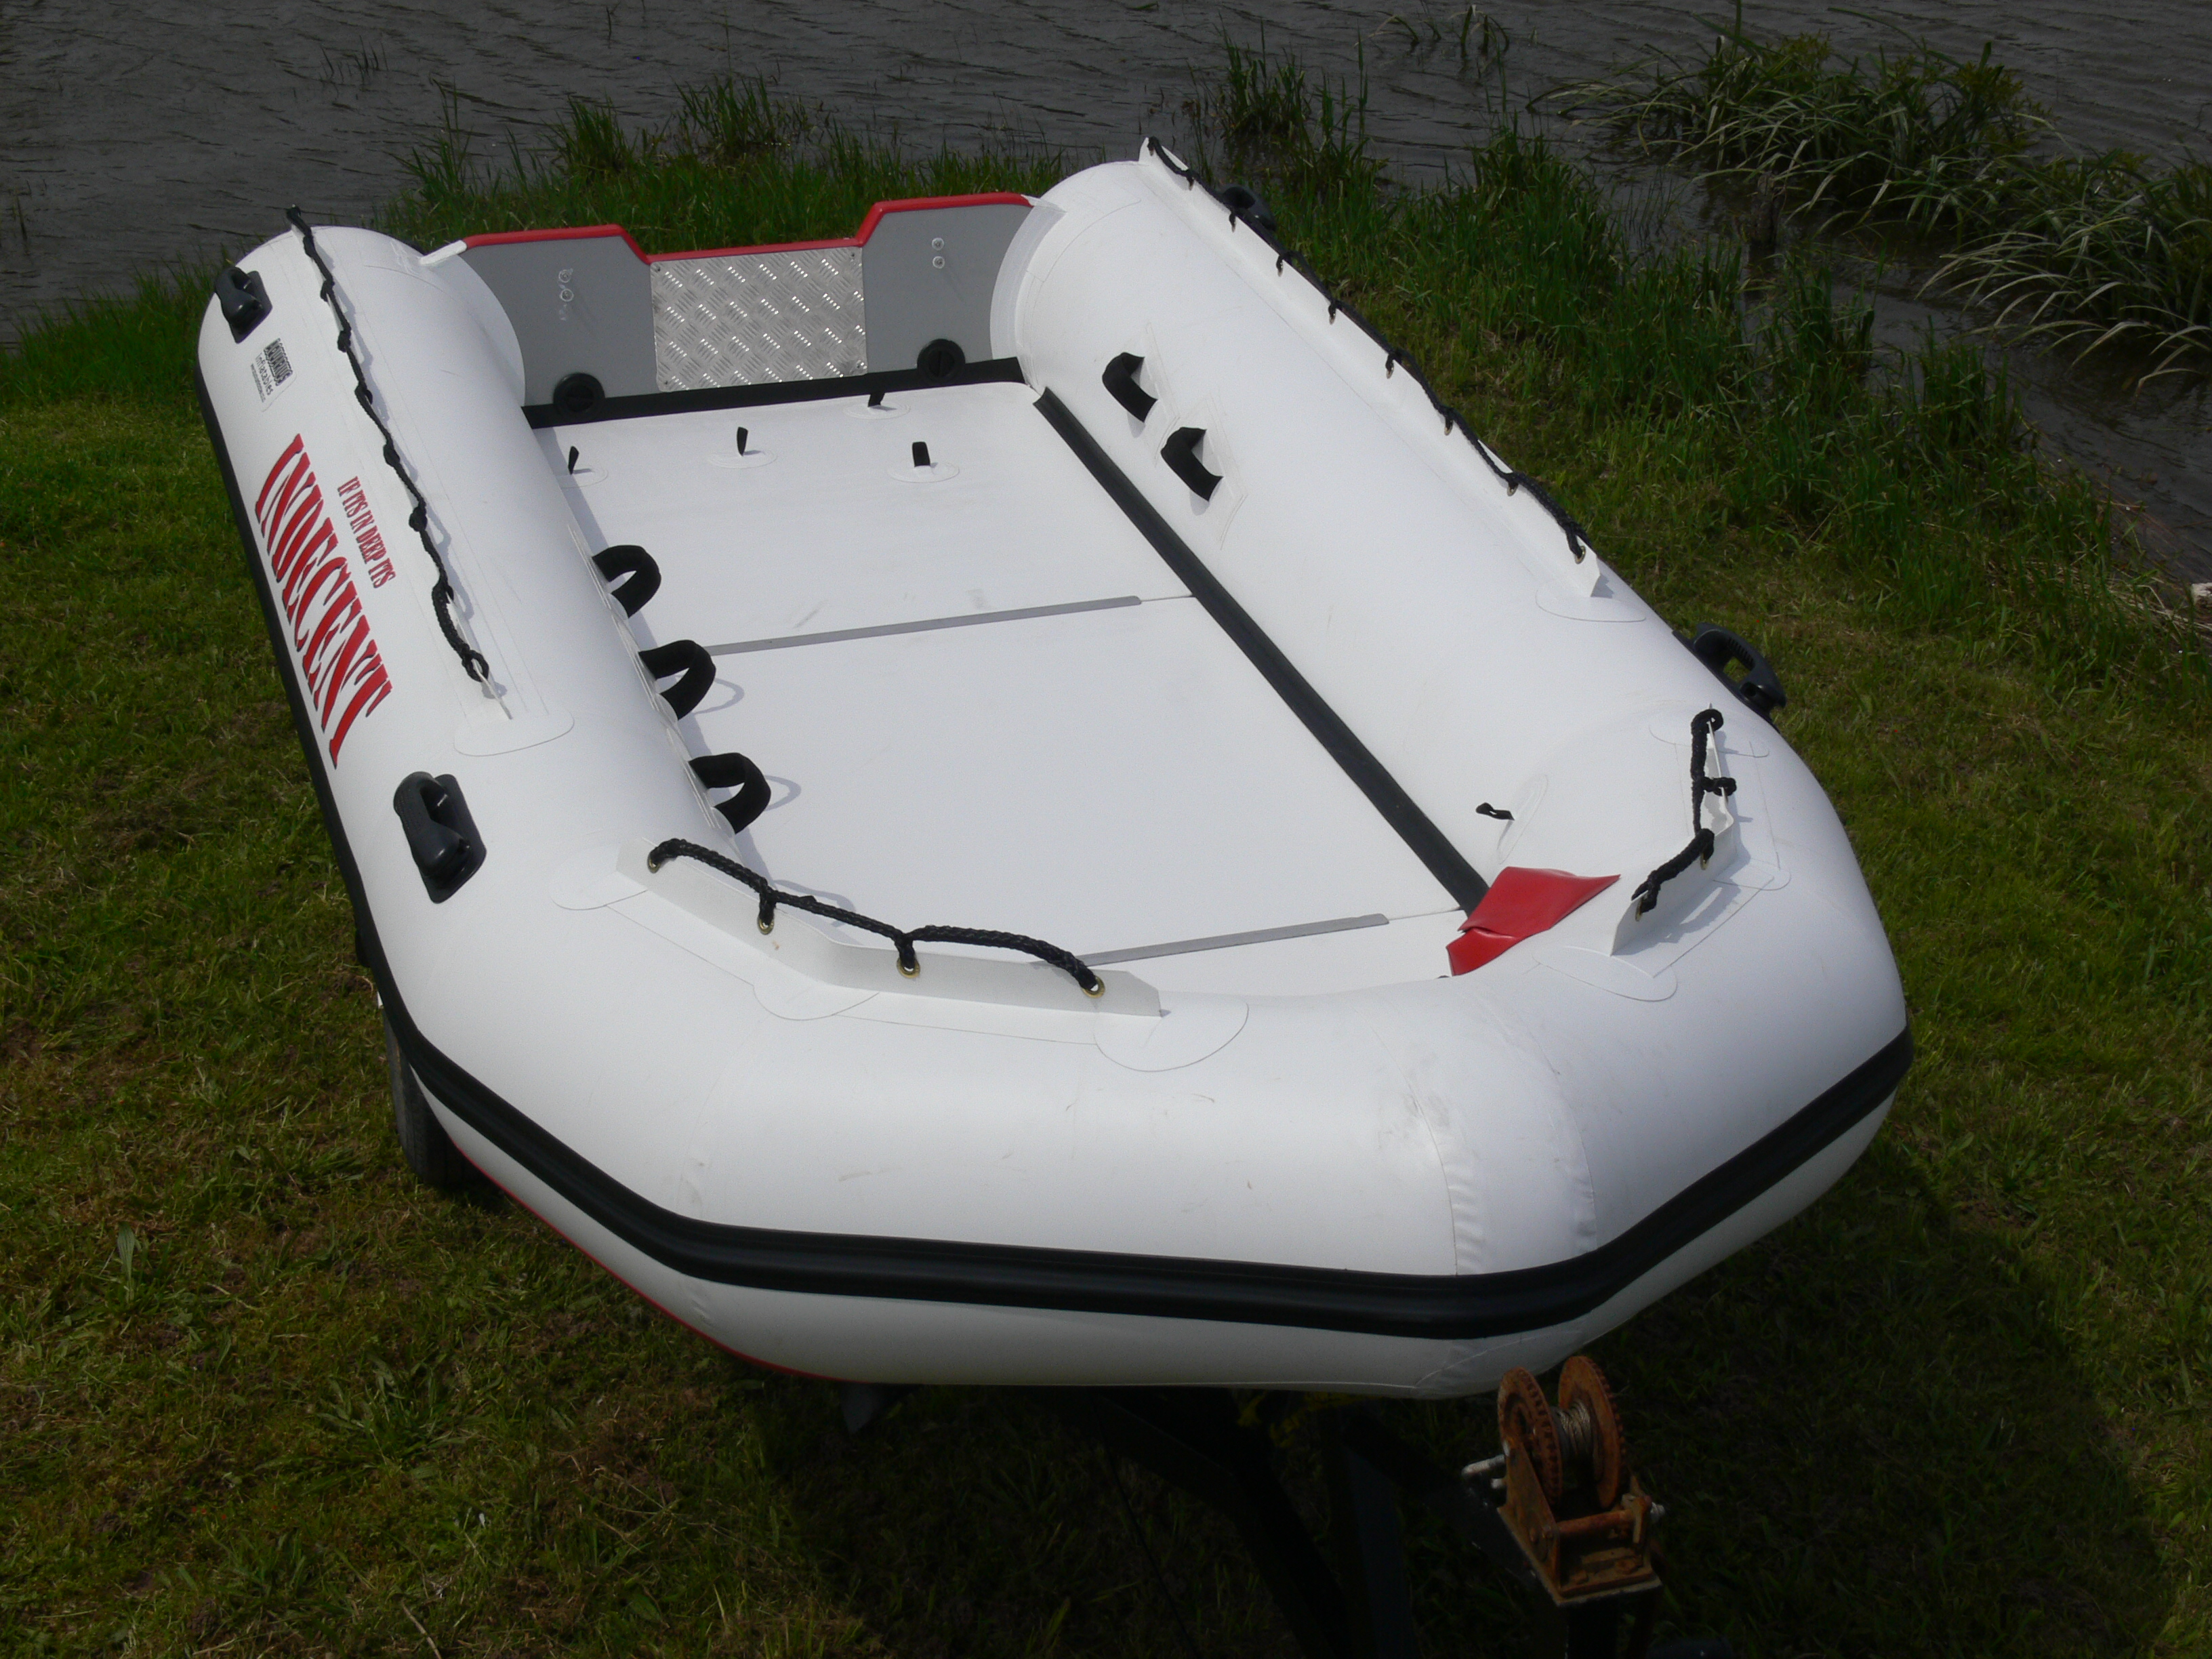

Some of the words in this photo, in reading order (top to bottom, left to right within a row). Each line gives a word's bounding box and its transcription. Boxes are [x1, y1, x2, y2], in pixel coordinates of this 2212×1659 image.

[255, 352, 274, 396] Inflatables
[263, 337, 293, 386] AQUARIUS
[337, 476, 362, 497] IF
[342, 489, 369, 518] ITS
[350, 510, 375, 534] IN
[356, 525, 387, 565] DEEP
[368, 558, 396, 588] ITS
[255, 433, 392, 769] INDECENT
